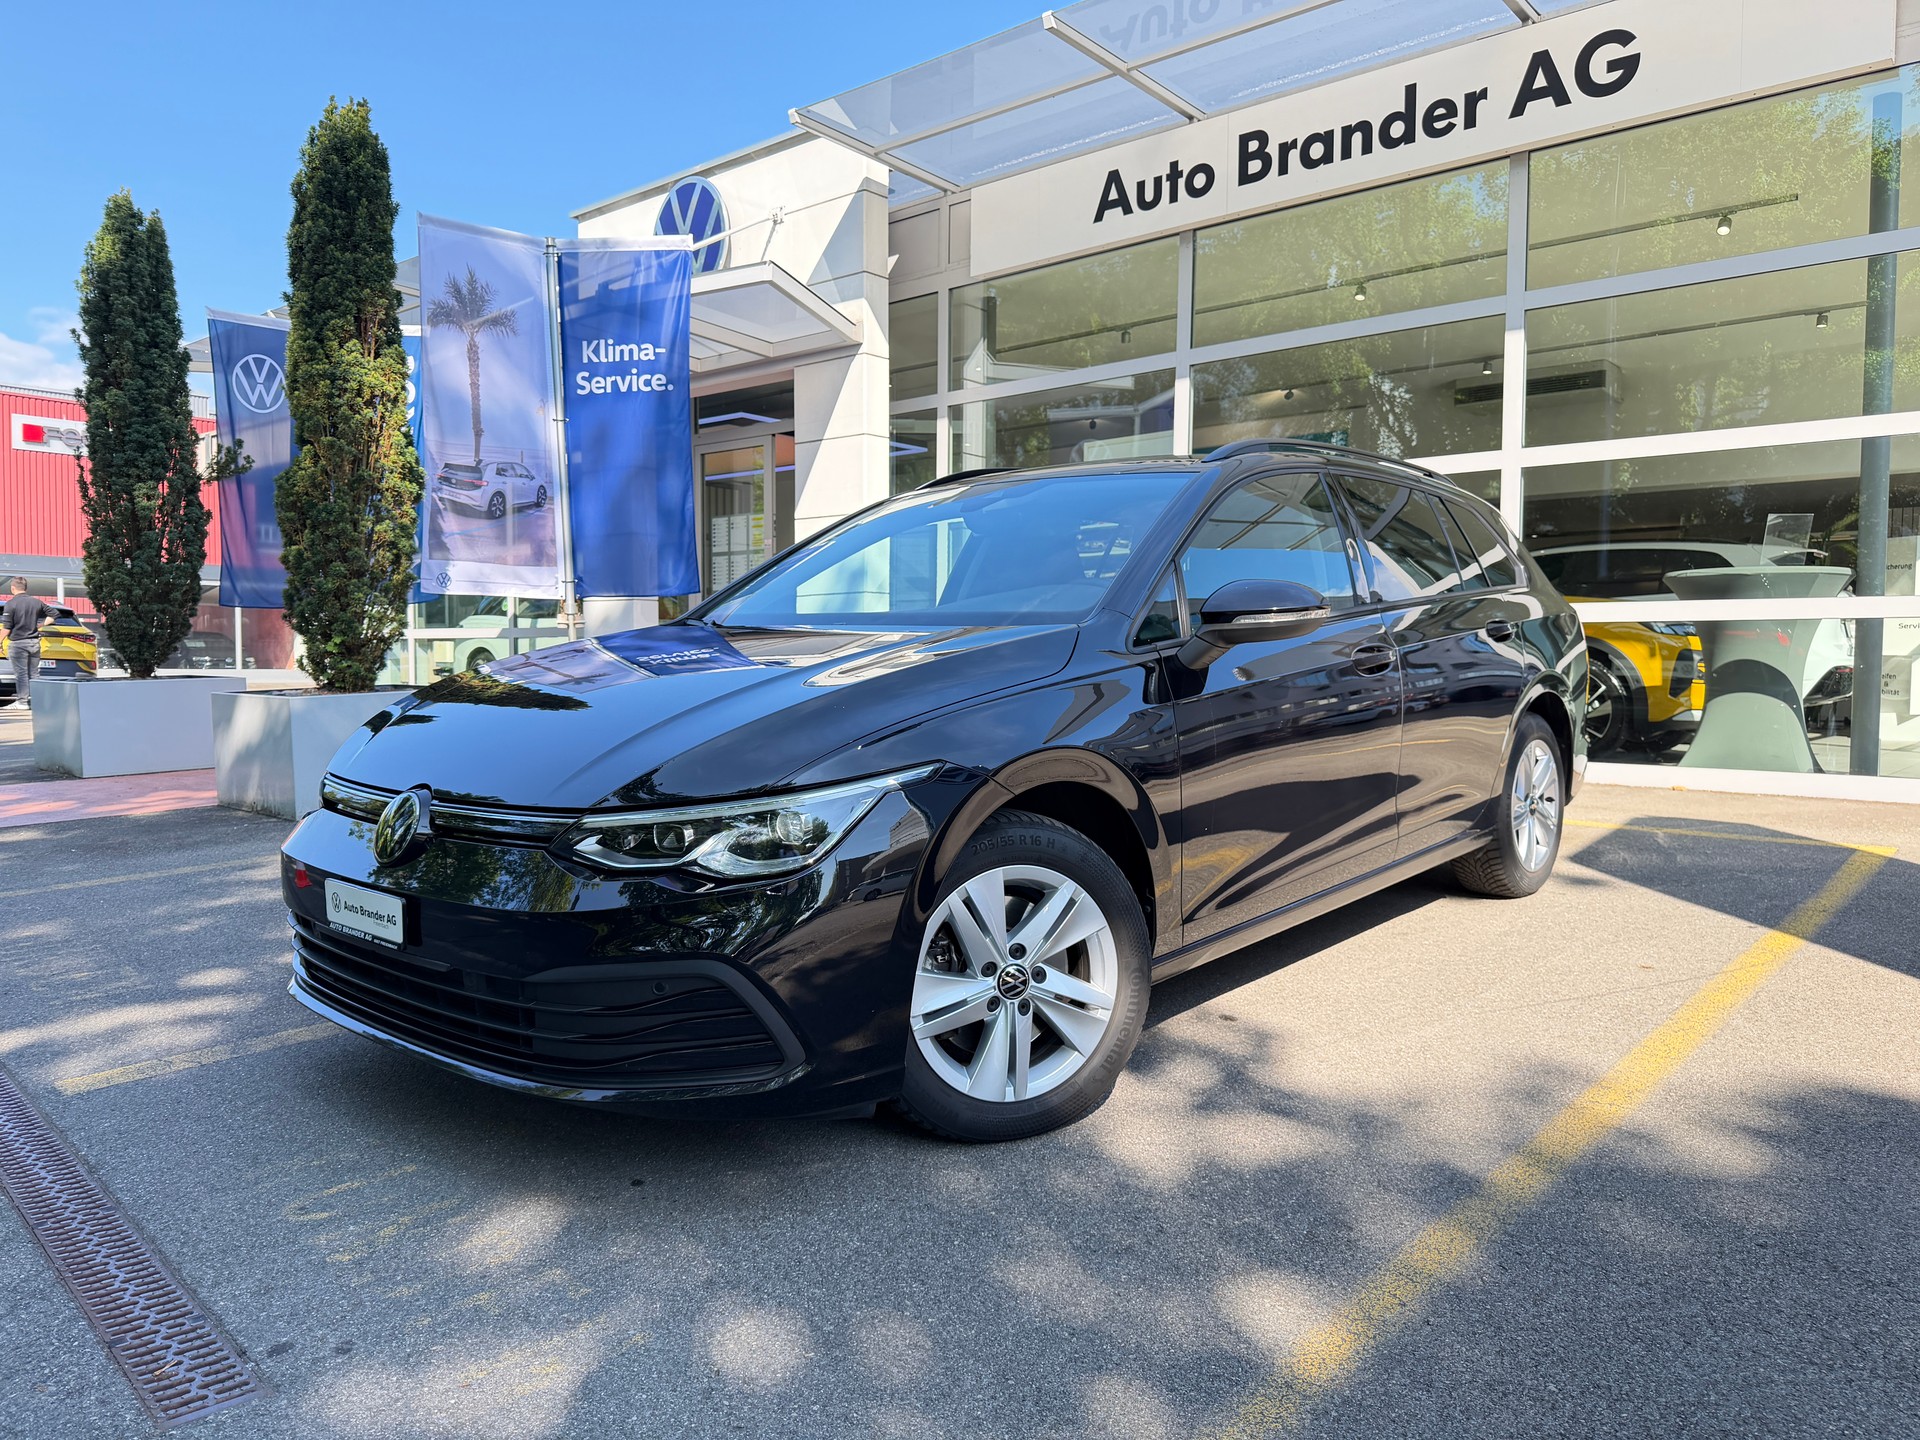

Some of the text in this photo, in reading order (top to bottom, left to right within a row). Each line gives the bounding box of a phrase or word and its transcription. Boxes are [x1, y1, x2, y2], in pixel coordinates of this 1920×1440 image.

[1093, 28, 1641, 223] Auto Brander AG
[581, 338, 666, 364] Klima-
[575, 367, 674, 395] Service.
[971, 834, 1015, 856] 205/55
[1019, 834, 1028, 846] R
[1030, 834, 1042, 847] 16
[343, 900, 359, 914] Auto
[359, 905, 386, 922] Brander
[386, 913, 397, 926] AG
[329, 921, 342, 932] AUTO
[342, 926, 365, 939] BRANDER
